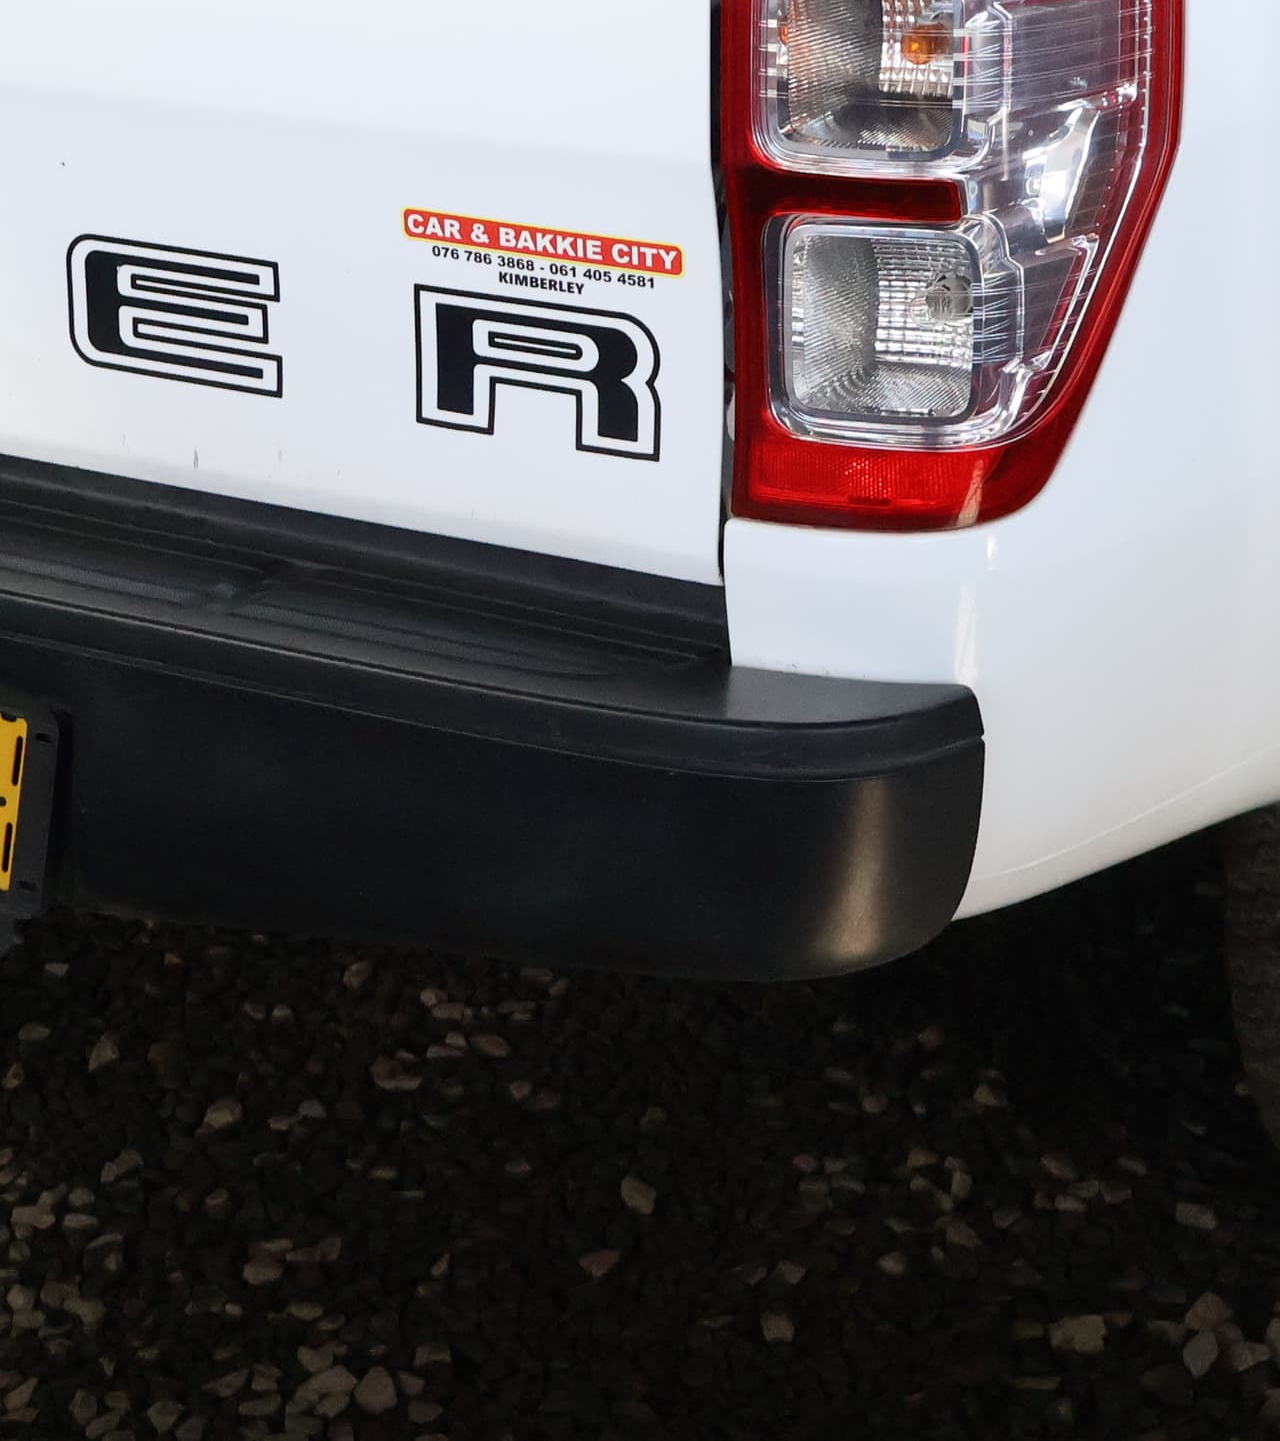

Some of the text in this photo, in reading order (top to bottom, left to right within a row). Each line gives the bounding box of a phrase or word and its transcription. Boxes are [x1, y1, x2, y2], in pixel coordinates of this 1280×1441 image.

[407, 214, 678, 270] CAR & BAKKIE CITY
[432, 245, 460, 260] 076
[465, 250, 492, 265] 786
[497, 255, 535, 271] 3868
[549, 264, 576, 278] 061
[583, 268, 612, 283] 405
[617, 273, 655, 289] 4581
[498, 272, 585, 295] KIMBERLEY
